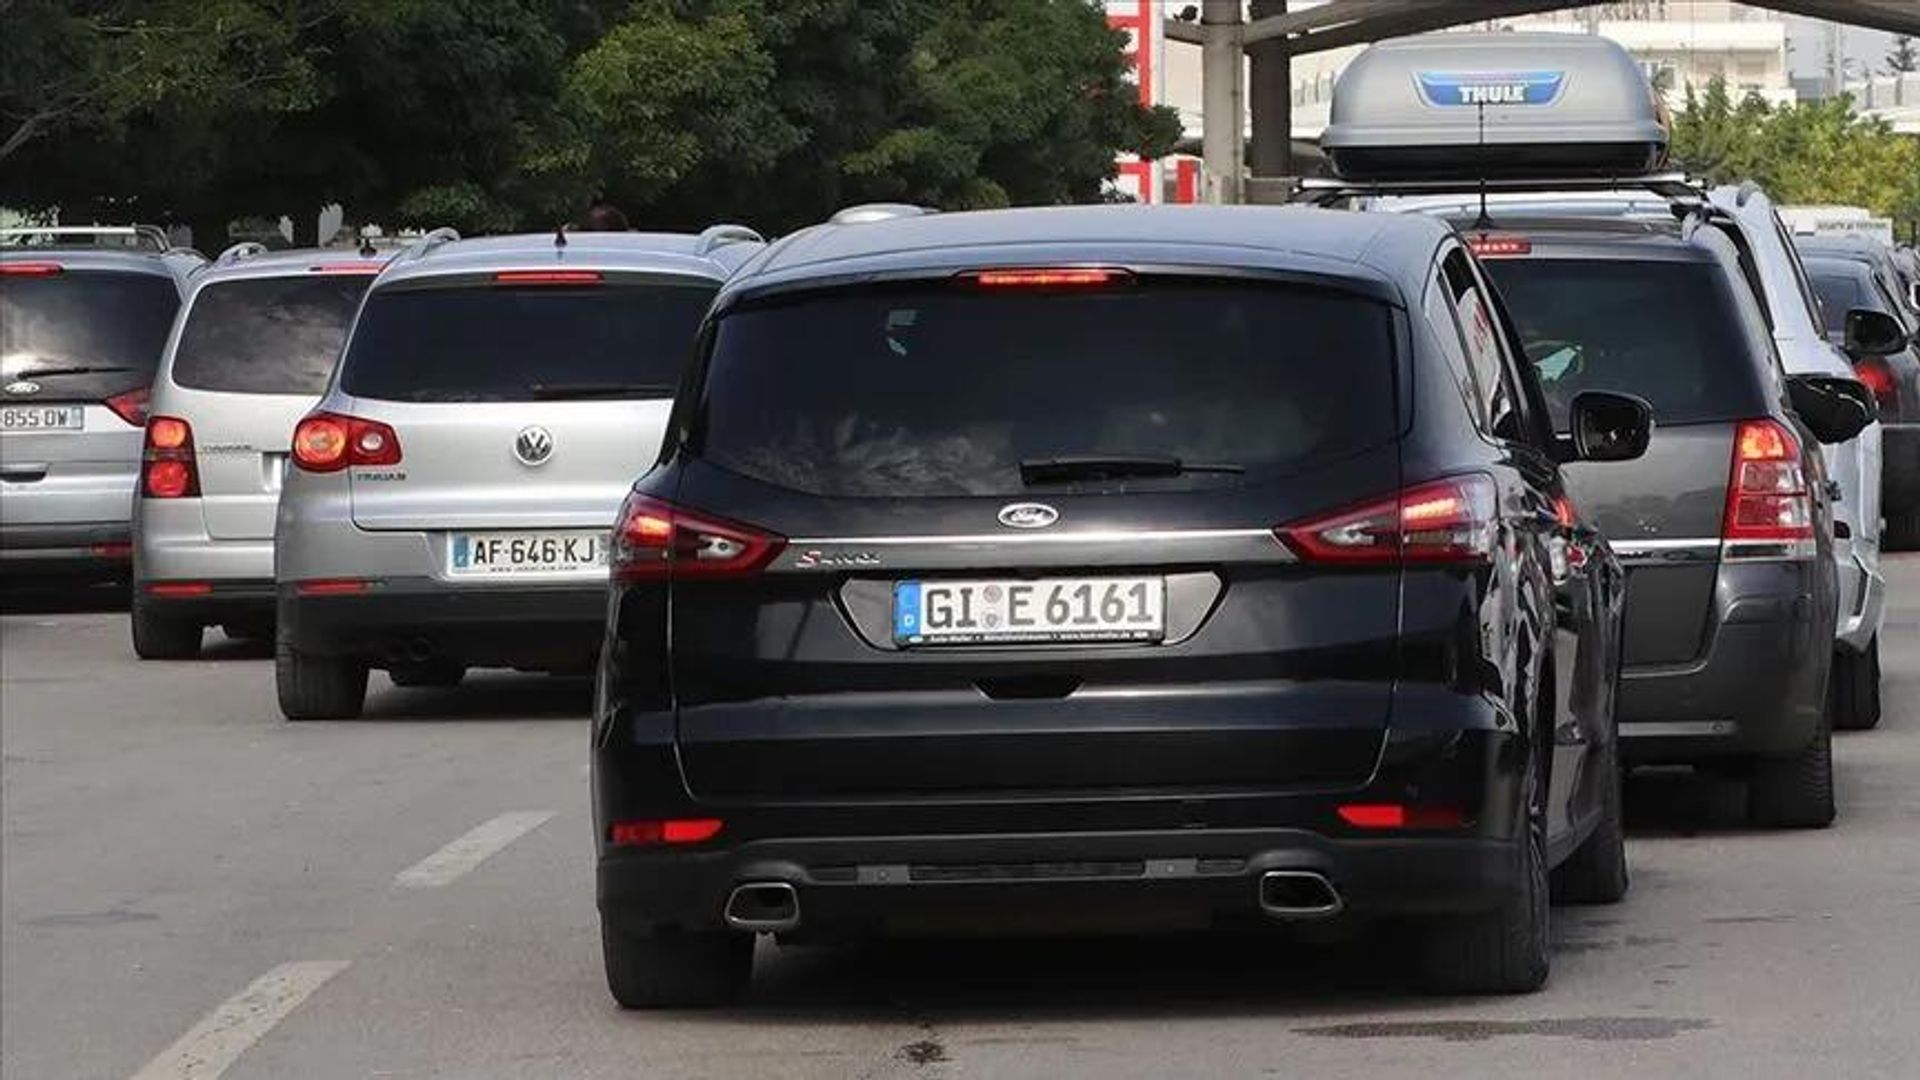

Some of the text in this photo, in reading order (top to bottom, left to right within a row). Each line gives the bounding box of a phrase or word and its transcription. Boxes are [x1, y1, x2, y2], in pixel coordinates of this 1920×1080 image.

[1458, 86, 1525, 103] THULE
[4, 409, 39, 427] 855
[926, 582, 1154, 628] GI E 6161
